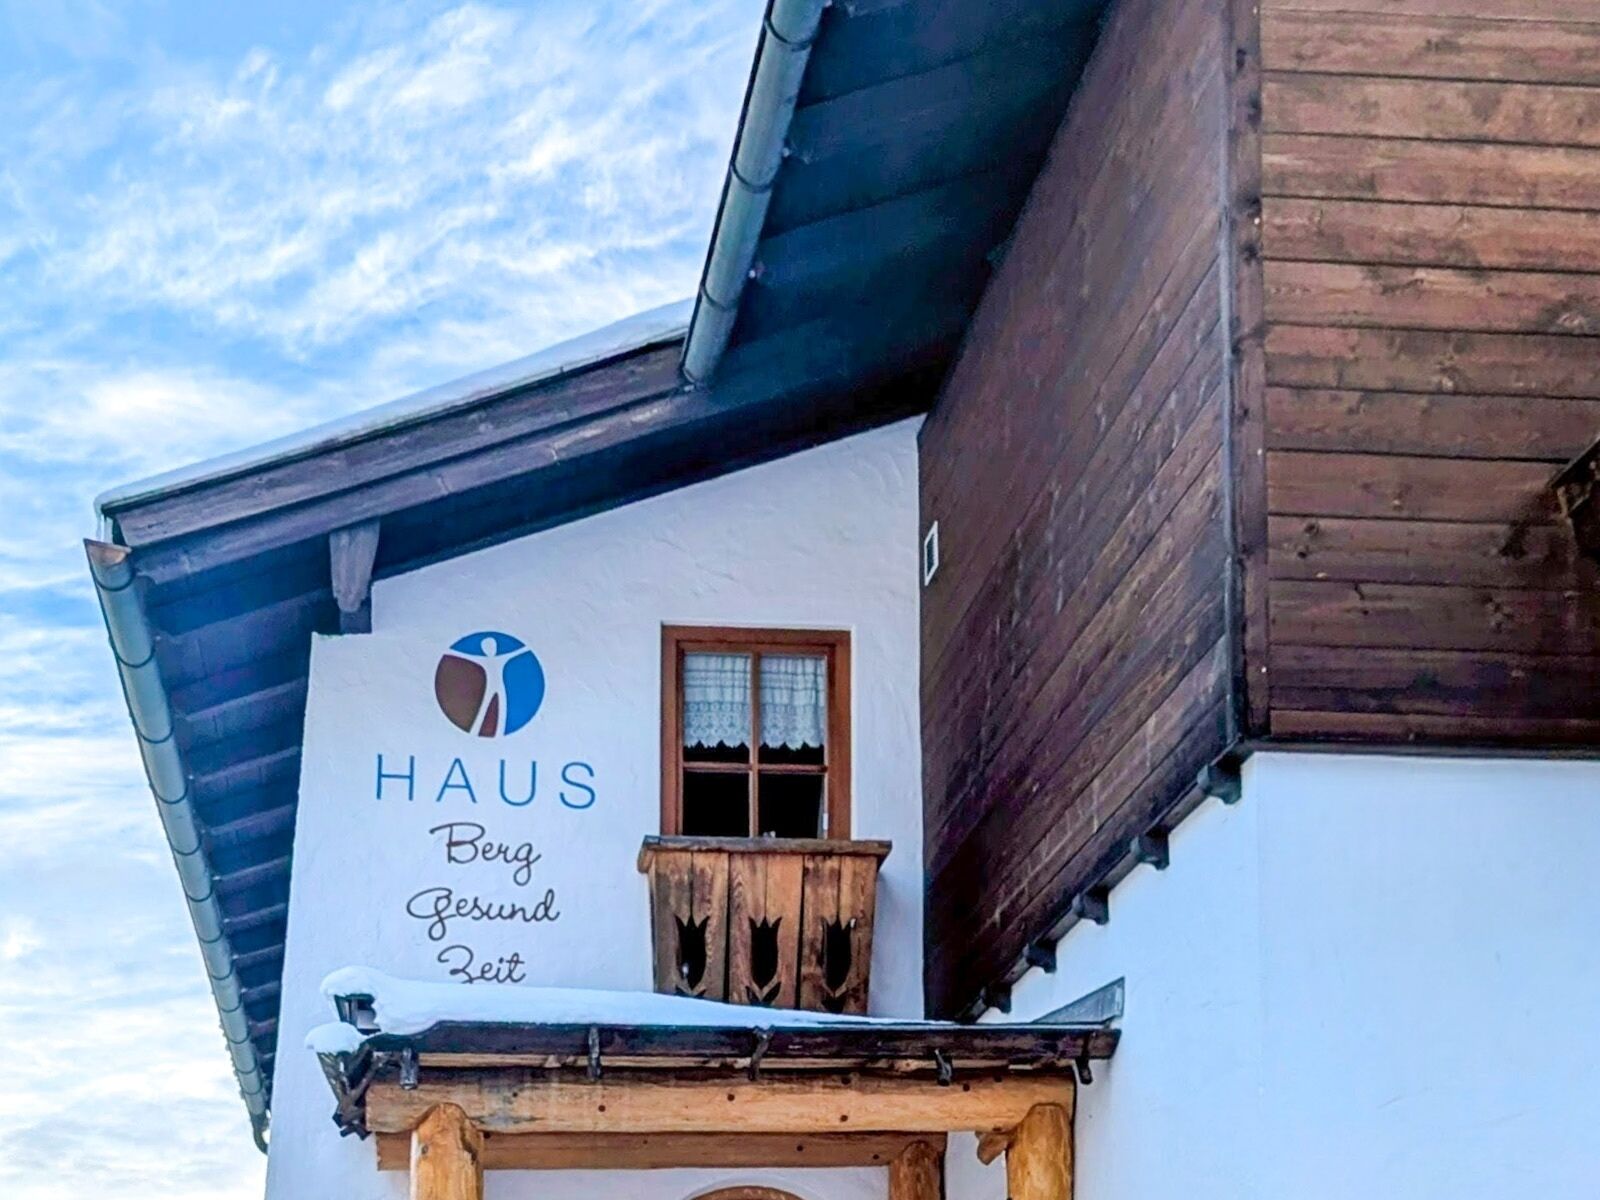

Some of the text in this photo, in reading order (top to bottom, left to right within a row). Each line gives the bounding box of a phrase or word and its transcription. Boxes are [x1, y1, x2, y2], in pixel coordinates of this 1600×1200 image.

[376, 753, 597, 810] HAUS
[429, 821, 542, 887] Berg
[406, 886, 561, 942] Gesund
[437, 944, 527, 985] Zeit
